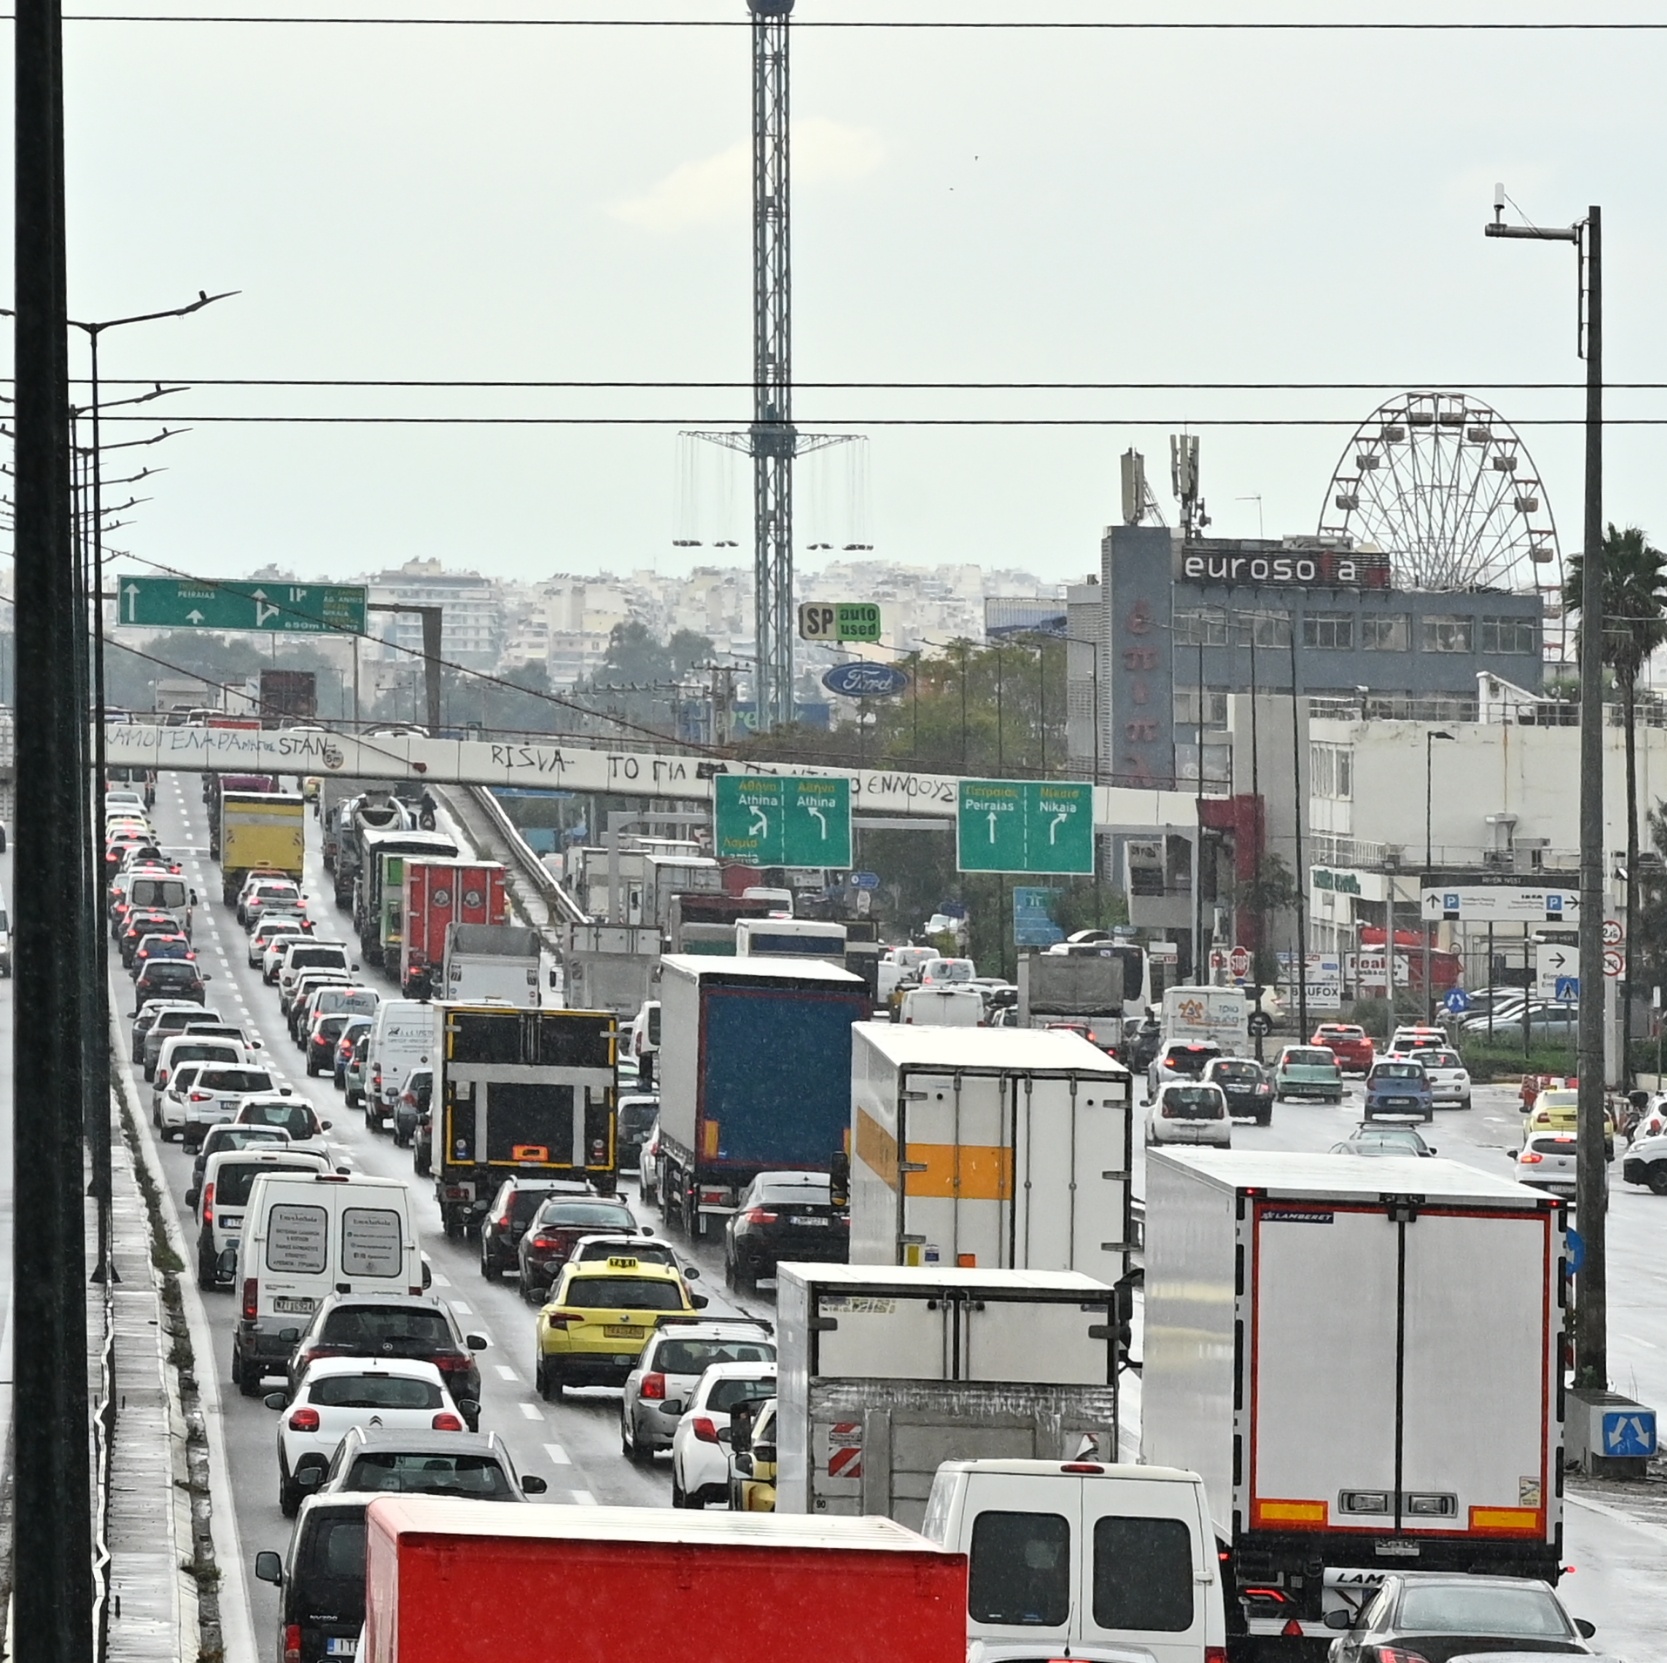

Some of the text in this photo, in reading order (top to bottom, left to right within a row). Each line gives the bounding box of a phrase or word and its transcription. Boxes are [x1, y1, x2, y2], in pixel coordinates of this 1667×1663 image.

[807, 608, 834, 635] SP
[840, 608, 876, 622] auto
[840, 622, 876, 636] used
[843, 668, 894, 690] Ford
[738, 794, 779, 807] Athina
[797, 794, 837, 808] Athina
[965, 800, 1014, 812] Peiraias
[1039, 801, 1077, 813] Nikaia
[1275, 1213, 1332, 1221] LAMBERET
[609, 1257, 637, 1268] TAXI
[816, 1500, 826, 1509] 90
